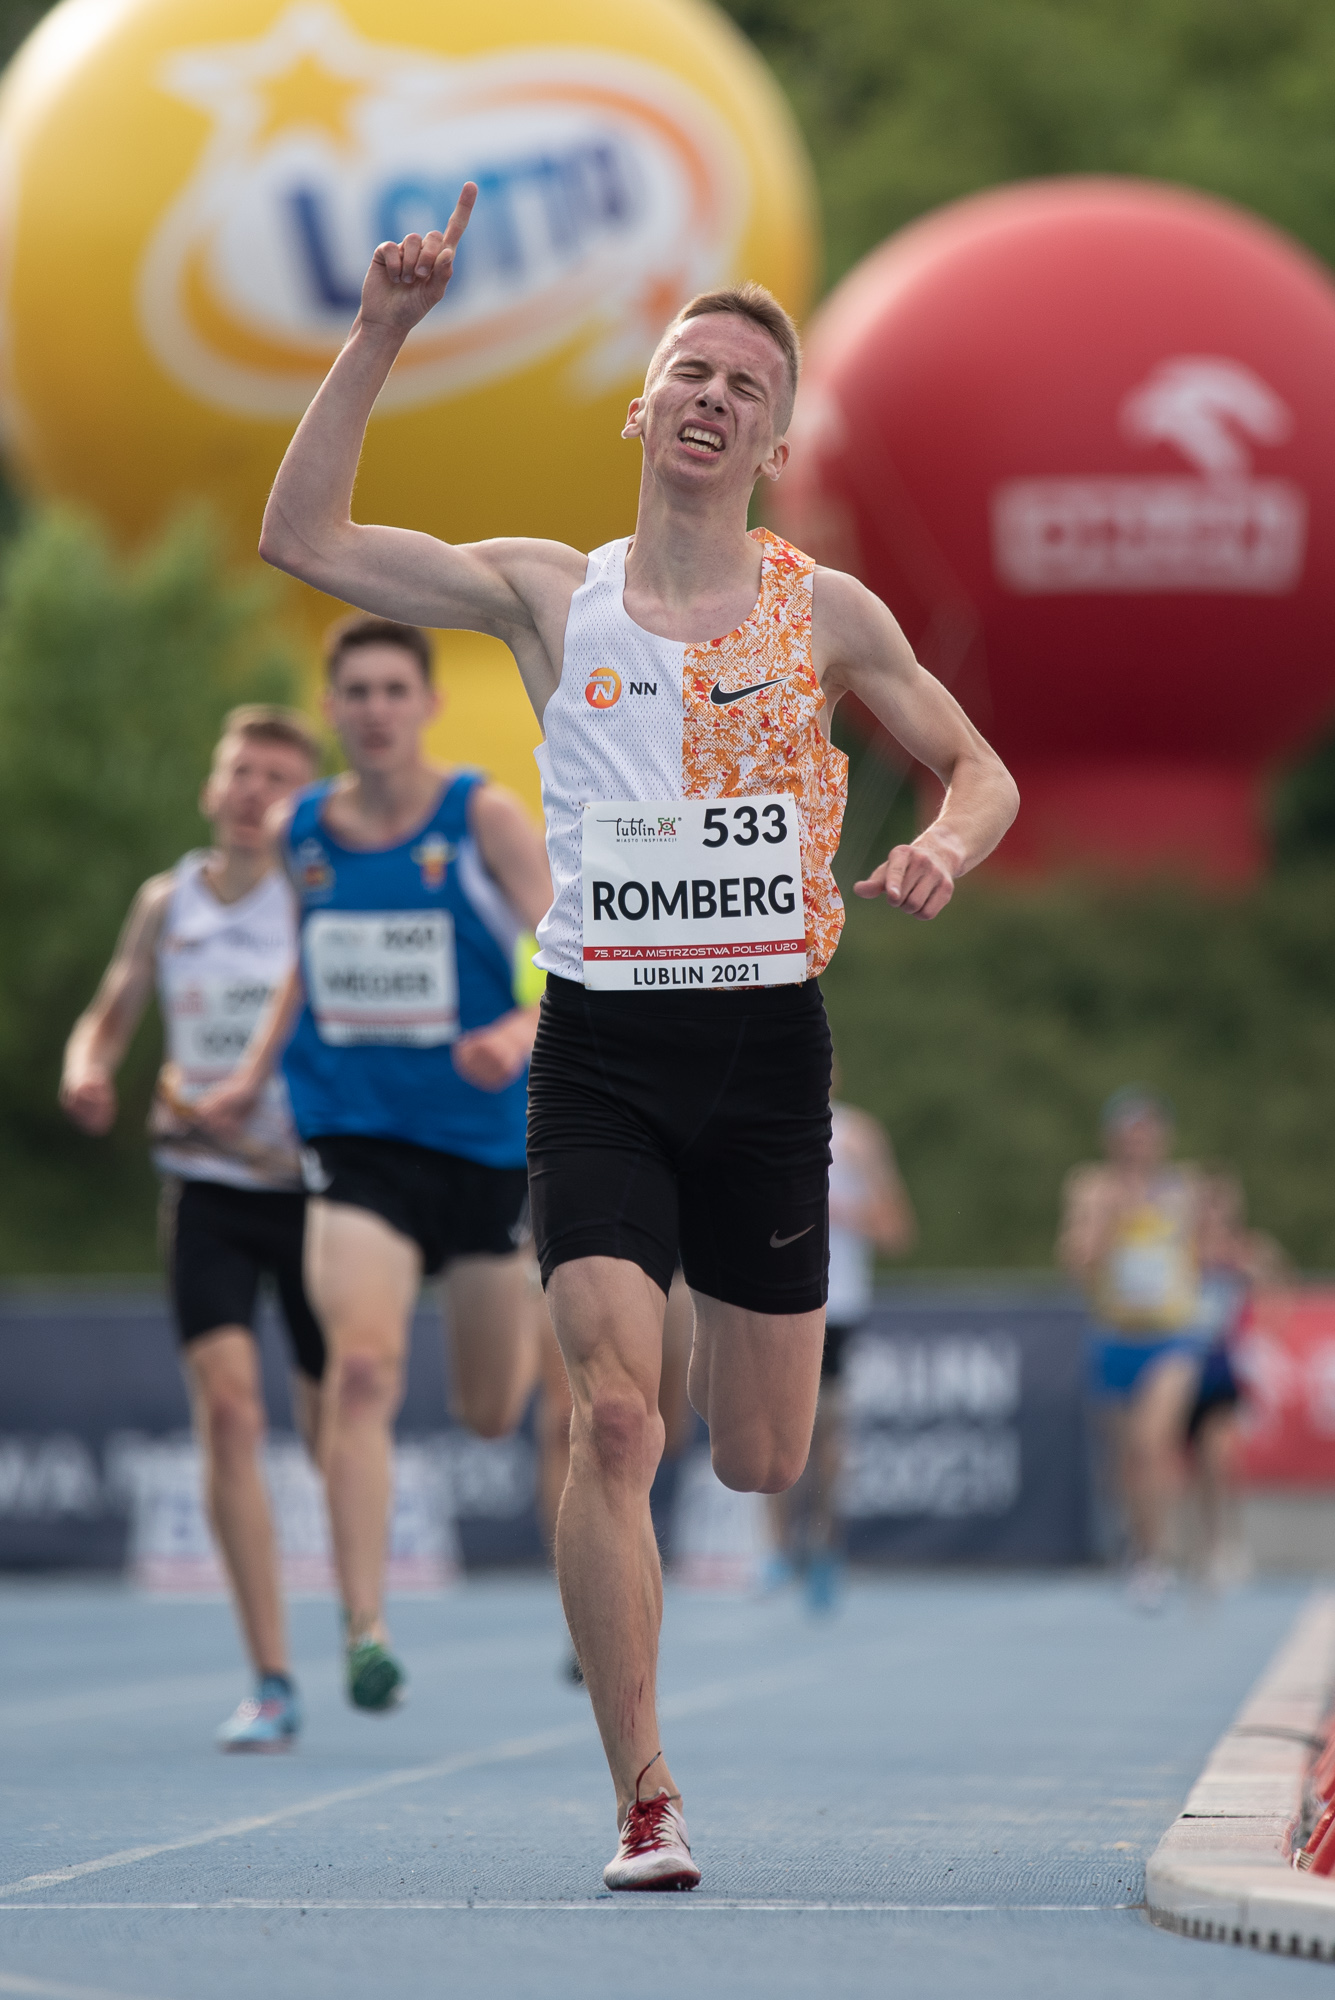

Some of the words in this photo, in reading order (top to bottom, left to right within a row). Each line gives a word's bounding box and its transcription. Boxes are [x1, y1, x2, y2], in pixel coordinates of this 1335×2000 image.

[629, 681, 657, 696] NN
[702, 804, 788, 848] 533
[592, 874, 796, 921] ROMBERG
[594, 949, 611, 958] 75.
[613, 949, 643, 958] PZLA
[645, 946, 729, 957] MISTRZOSTWA
[732, 943, 773, 954] POLSKI
[775, 942, 798, 952] U20
[633, 965, 704, 986] LUBLIN
[711, 963, 760, 983] 2021
